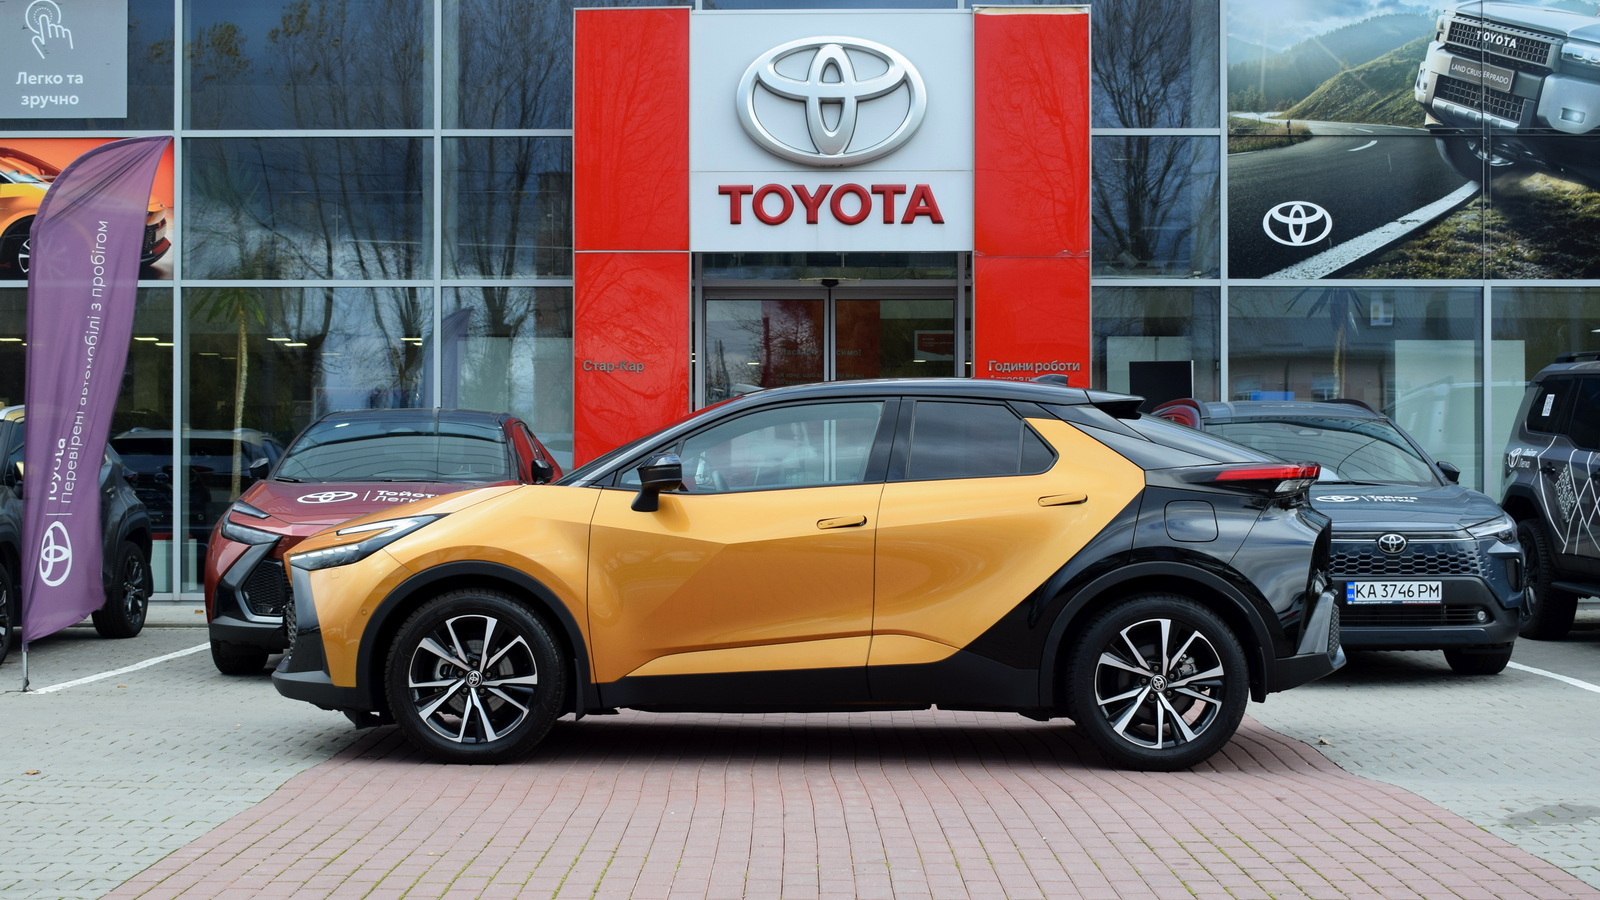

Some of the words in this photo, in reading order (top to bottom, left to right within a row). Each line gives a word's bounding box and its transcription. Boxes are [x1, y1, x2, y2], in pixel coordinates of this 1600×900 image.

[1476, 30, 1517, 48] TOYOTA
[16, 72, 63, 84] Легко
[66, 74, 84, 84] та
[1451, 63, 1466, 73] LAND
[1489, 73, 1509, 84] PRADO
[20, 94, 79, 108] зручно
[718, 183, 945, 225] TOYOTA
[91, 221, 109, 297] пробігом
[91, 303, 102, 311] з
[582, 360, 645, 374] Стар-Кар
[988, 360, 1033, 373] Години
[1035, 360, 1081, 374] роботи
[61, 411, 85, 503] Перевірені
[1355, 584, 1377, 598] KA
[1380, 584, 1415, 598] 3746
[1418, 584, 1440, 598] PM
